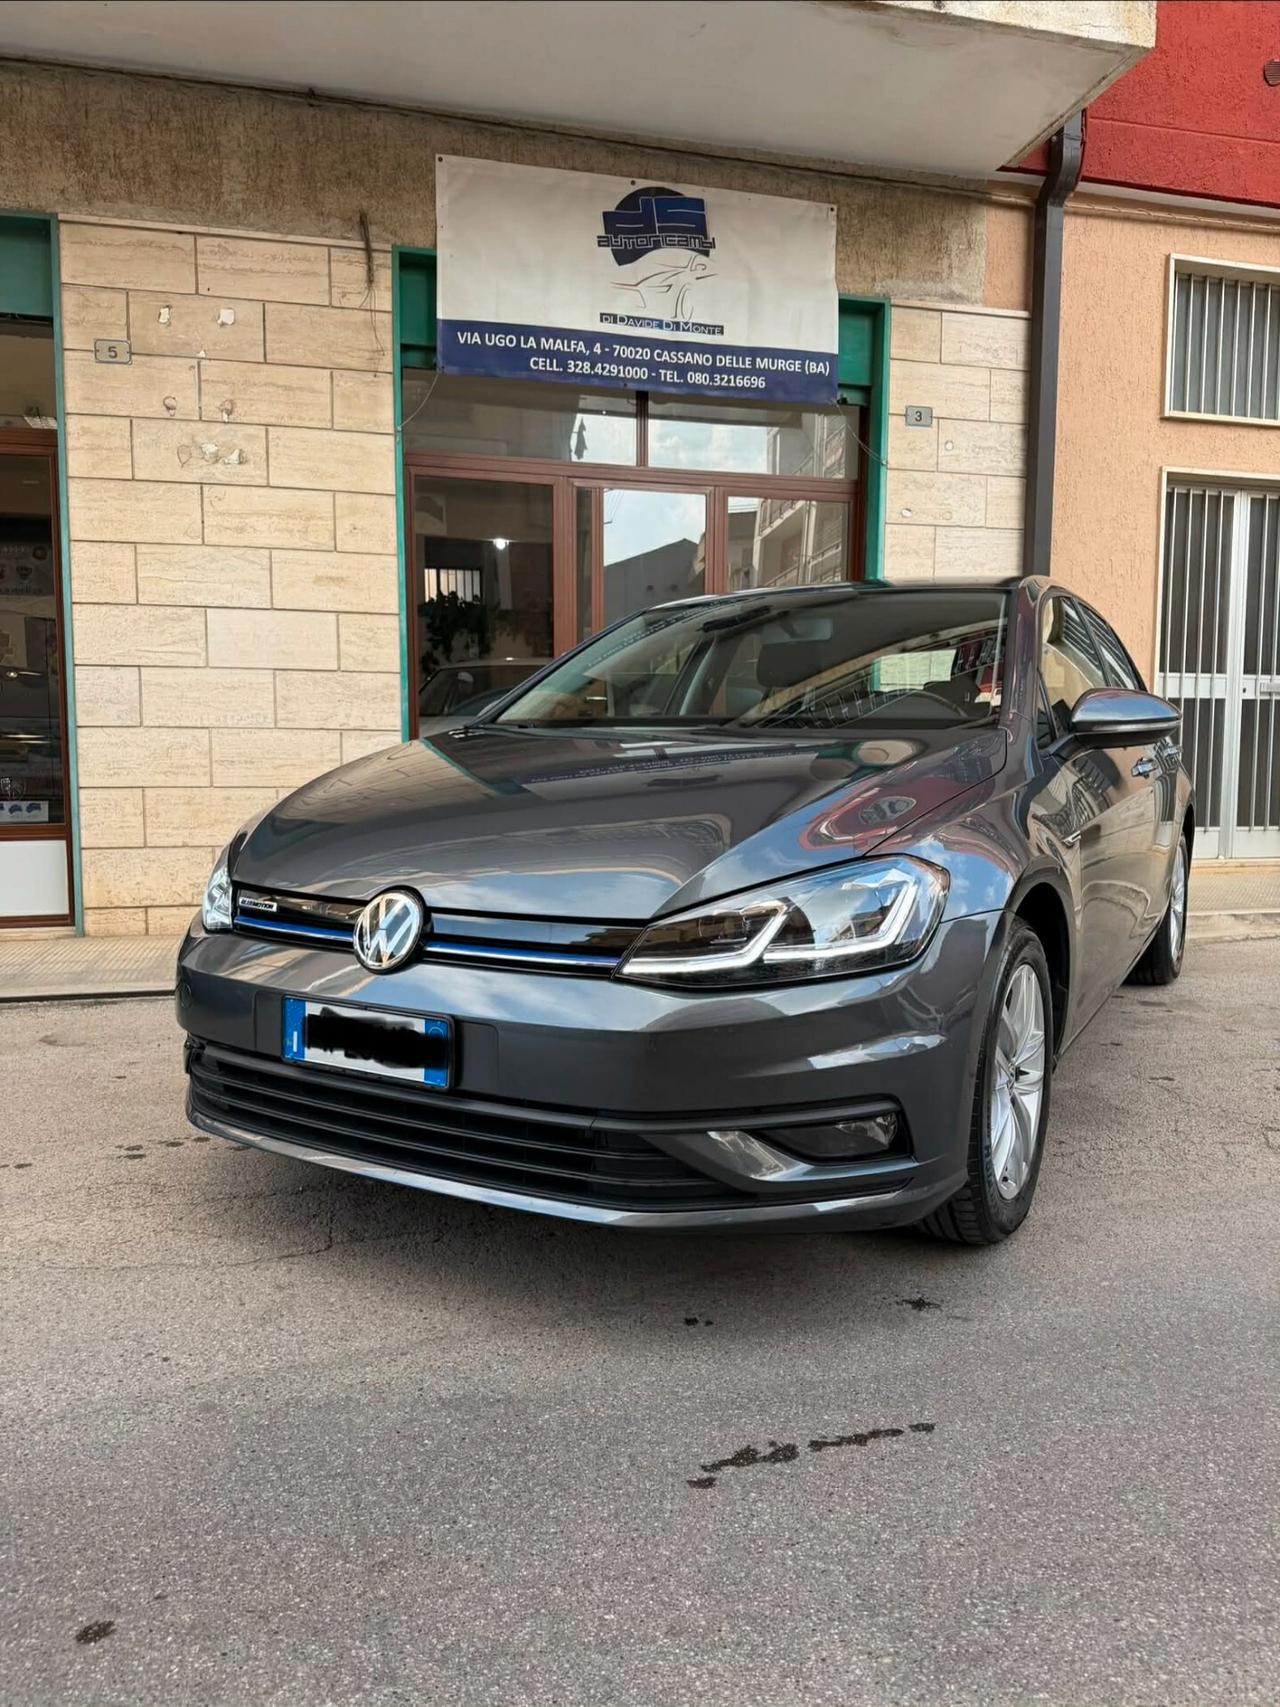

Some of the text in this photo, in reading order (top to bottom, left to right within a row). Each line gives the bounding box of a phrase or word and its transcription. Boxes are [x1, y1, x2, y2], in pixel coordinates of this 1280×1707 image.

[108, 345, 118, 359] 5
[457, 331, 481, 345] VIA
[485, 333, 516, 347] UGO
[520, 336, 537, 349] LA
[540, 337, 590, 356] MALFA,
[593, 342, 602, 355] 4
[613, 345, 650, 360] 70020
[654, 349, 713, 366] CASSANO
[716, 354, 752, 369] DELLE
[756, 357, 802, 372] MURGE
[805, 359, 830, 376] (BA)
[529, 357, 563, 371] CELL.
[567, 360, 648, 379] 328.4291000
[659, 369, 683, 383] TEL.
[687, 372, 766, 388] 080.3216696
[915, 410, 922, 422] 3
